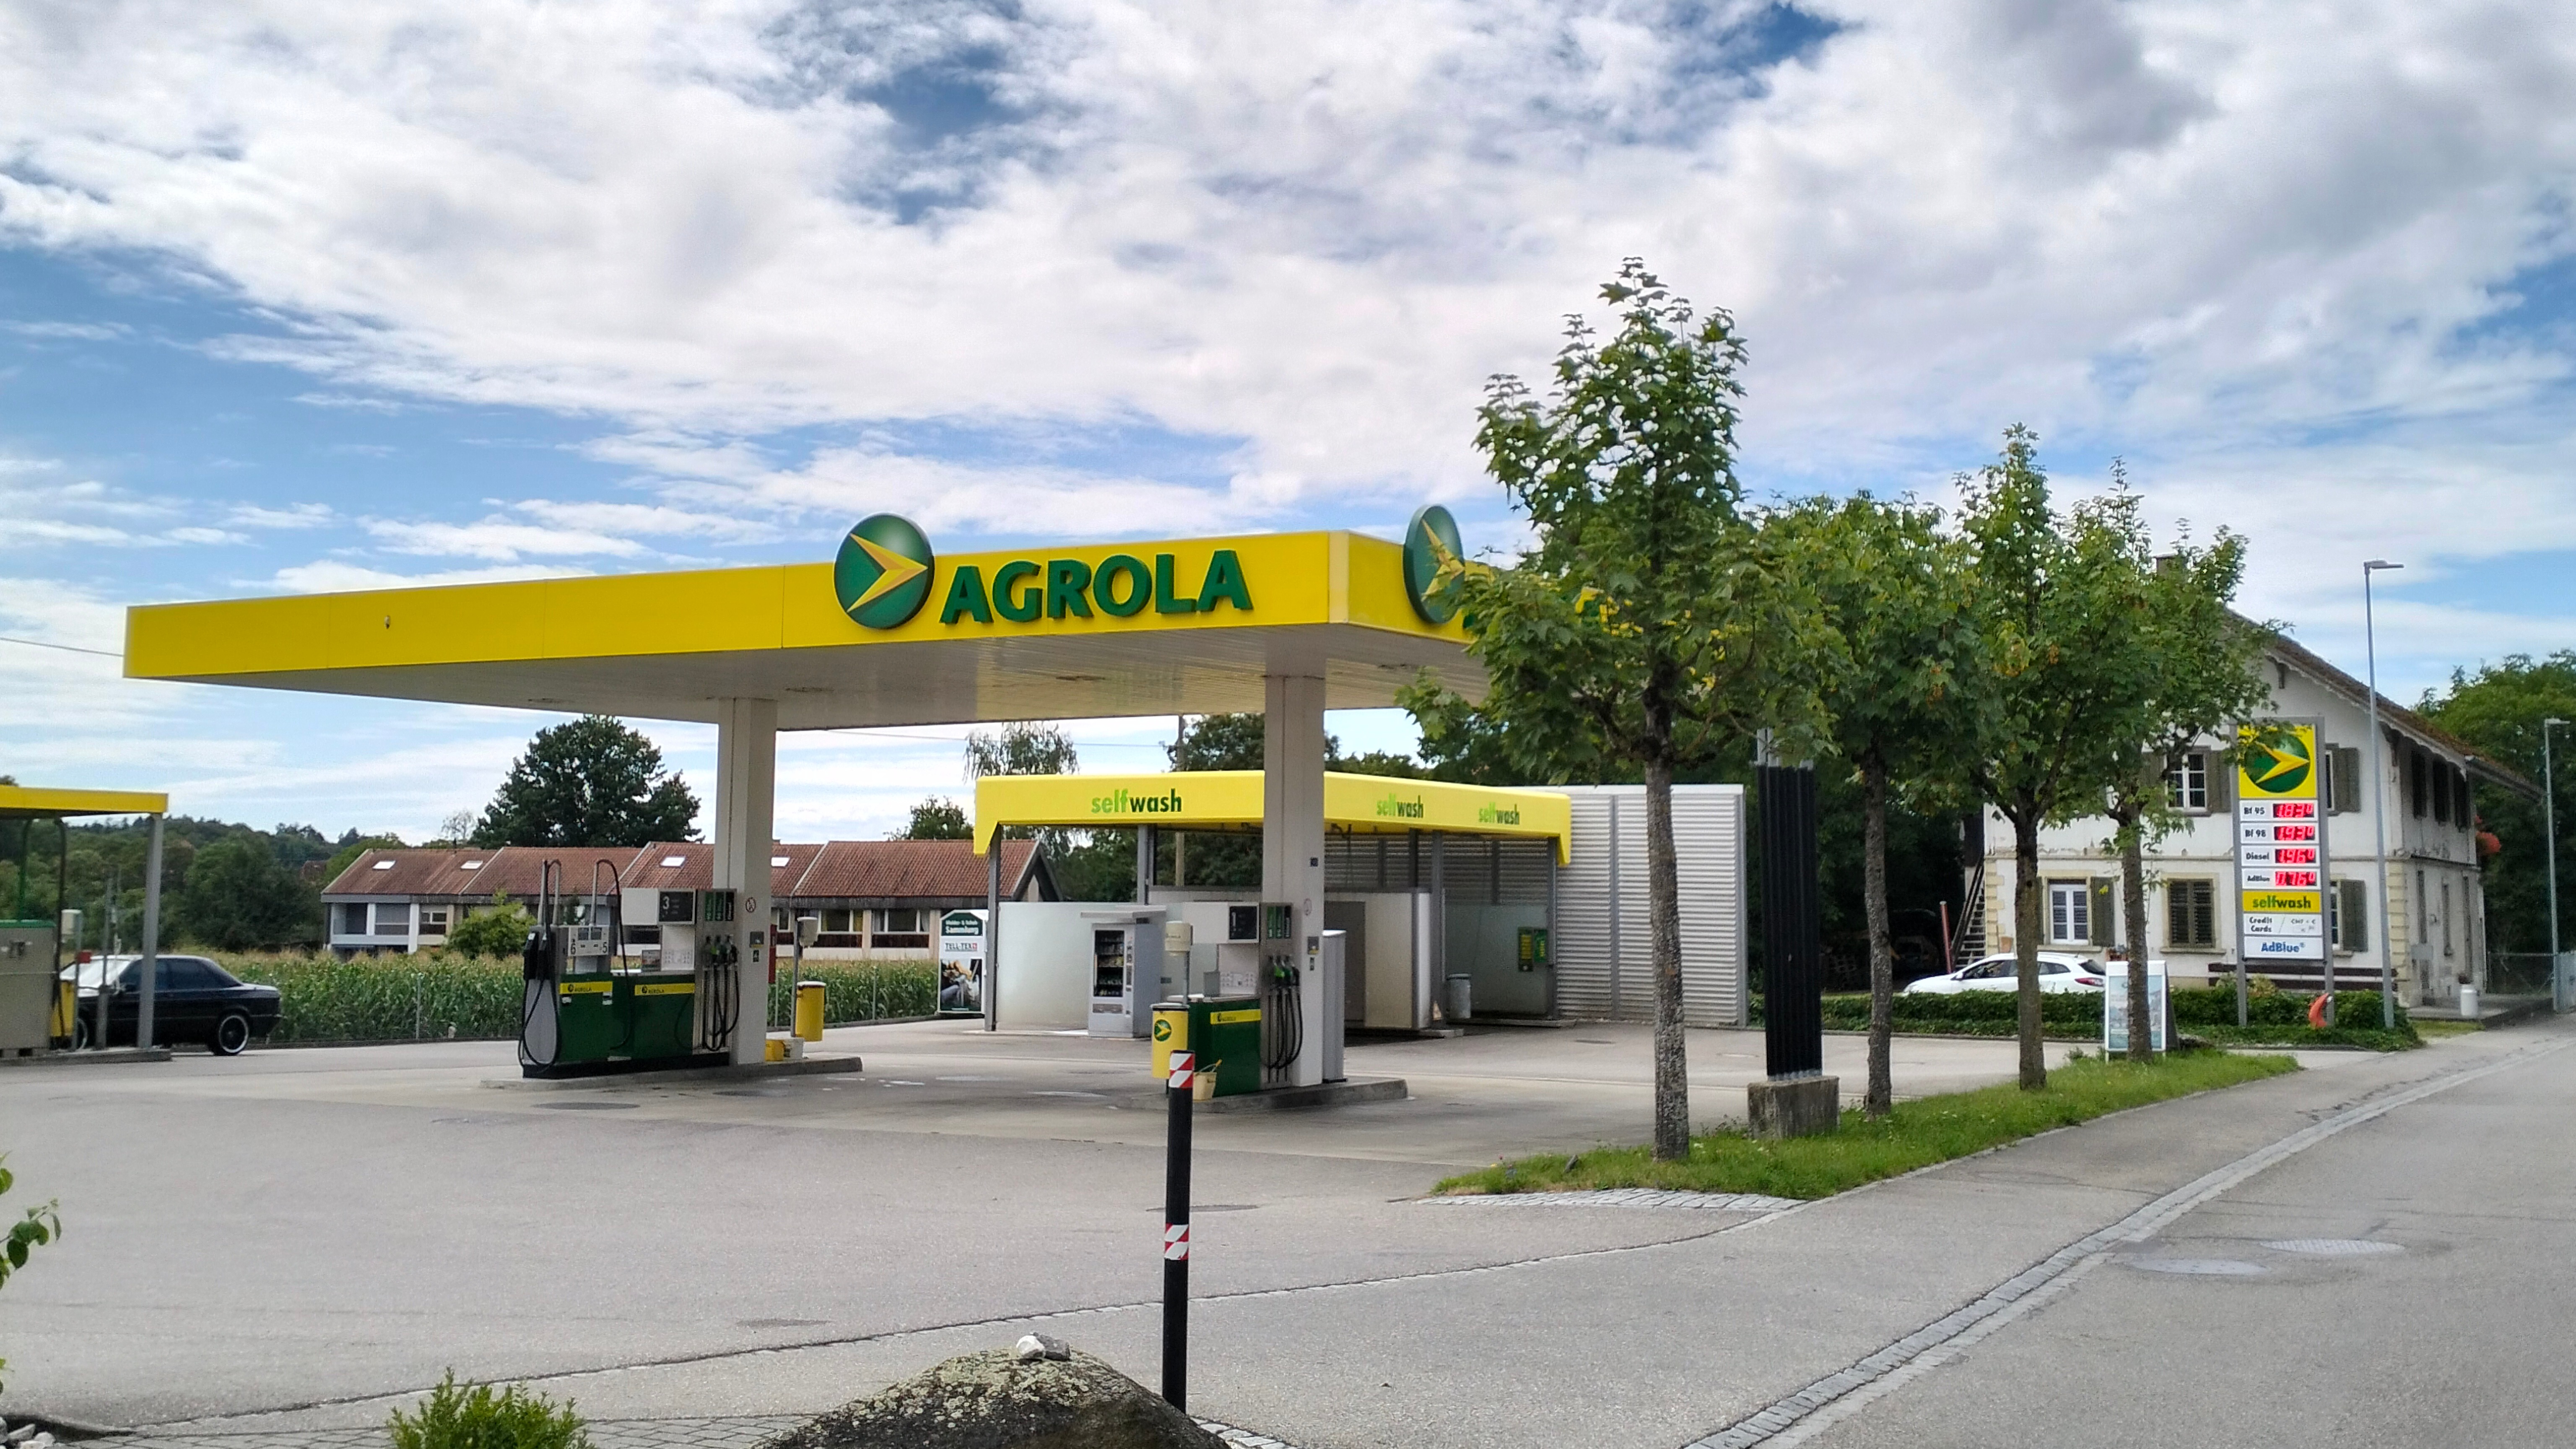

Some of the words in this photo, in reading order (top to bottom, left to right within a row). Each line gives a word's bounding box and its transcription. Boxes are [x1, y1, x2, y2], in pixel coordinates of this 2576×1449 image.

[939, 549, 1254, 624] AGROLA
[1091, 788, 1182, 813] selfwash
[1376, 793, 1424, 818] selfwash
[1479, 802, 1520, 825] selfwash
[662, 896, 670, 910] 3
[2252, 895, 2311, 908] selfwash
